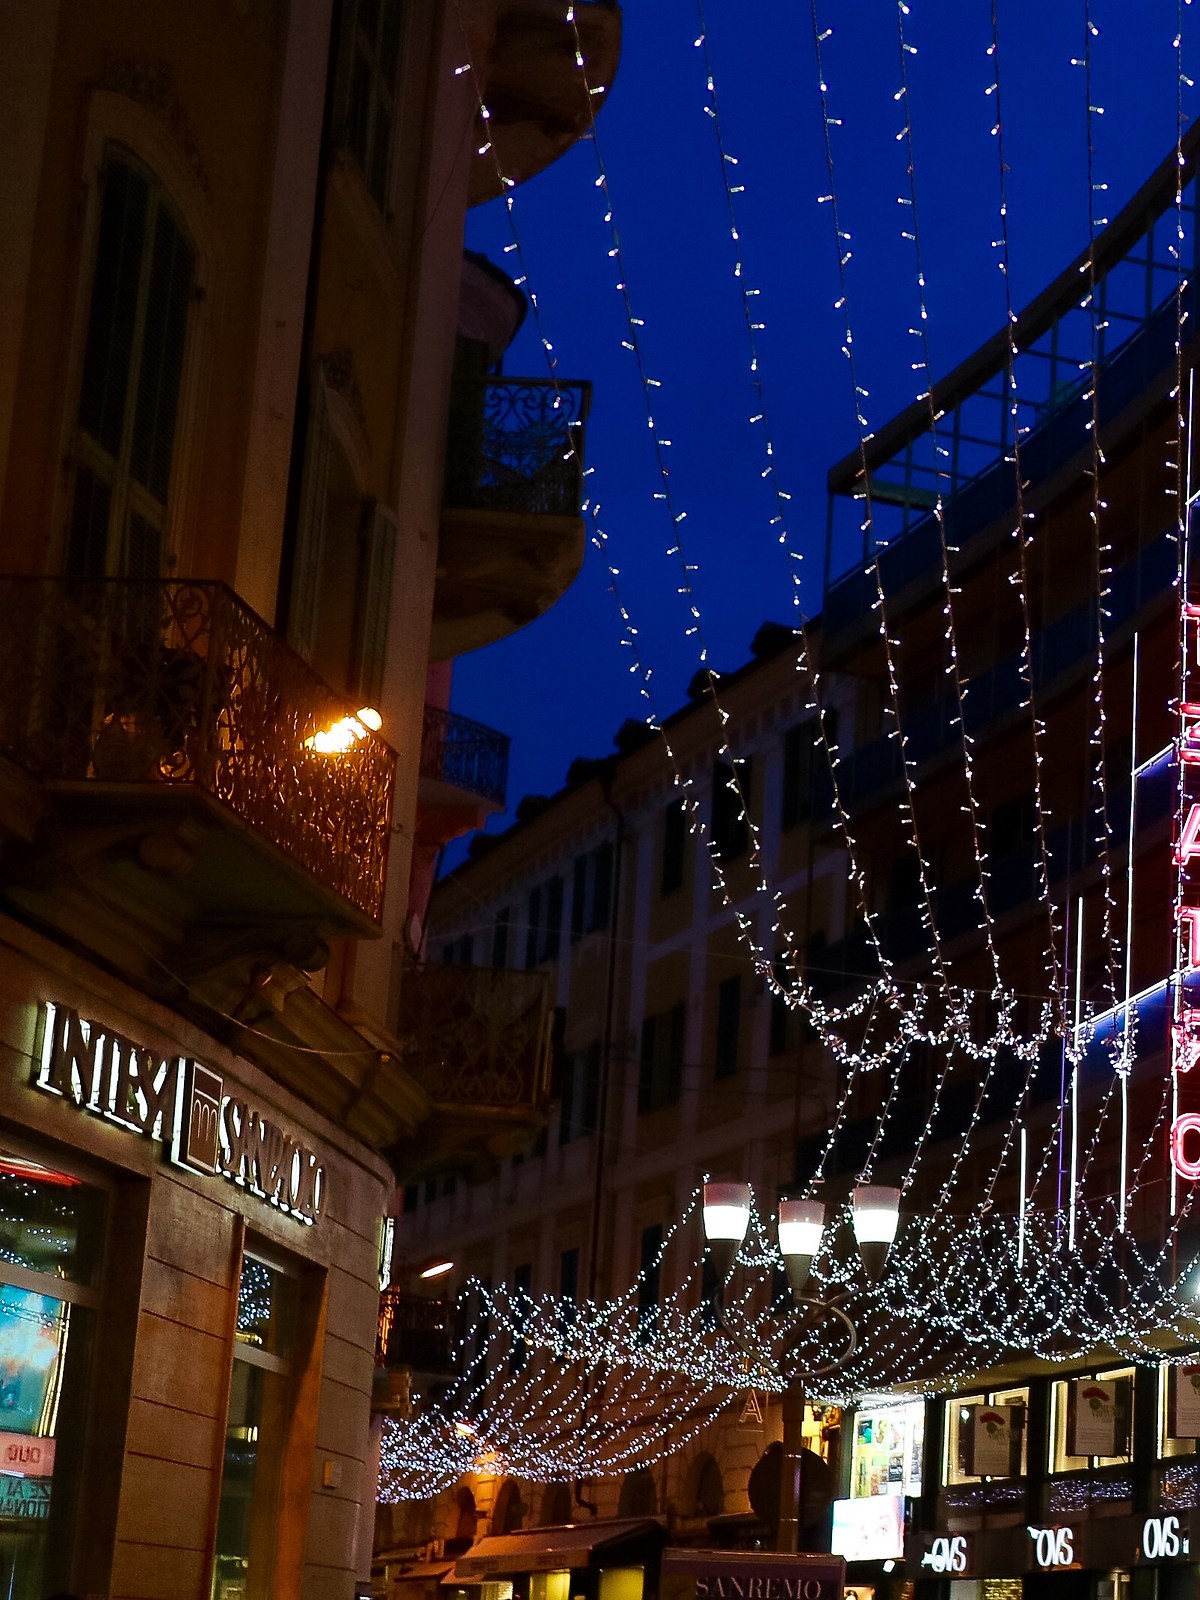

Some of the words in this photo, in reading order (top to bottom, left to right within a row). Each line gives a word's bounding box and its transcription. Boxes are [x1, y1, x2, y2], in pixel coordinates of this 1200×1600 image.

[36, 1000, 175, 1142] INTESA
[932, 1536, 967, 1572] OVS
[1037, 1527, 1074, 1566] OVS
[1143, 1516, 1180, 1558] OVS
[696, 1577, 822, 1600] SANREMO
